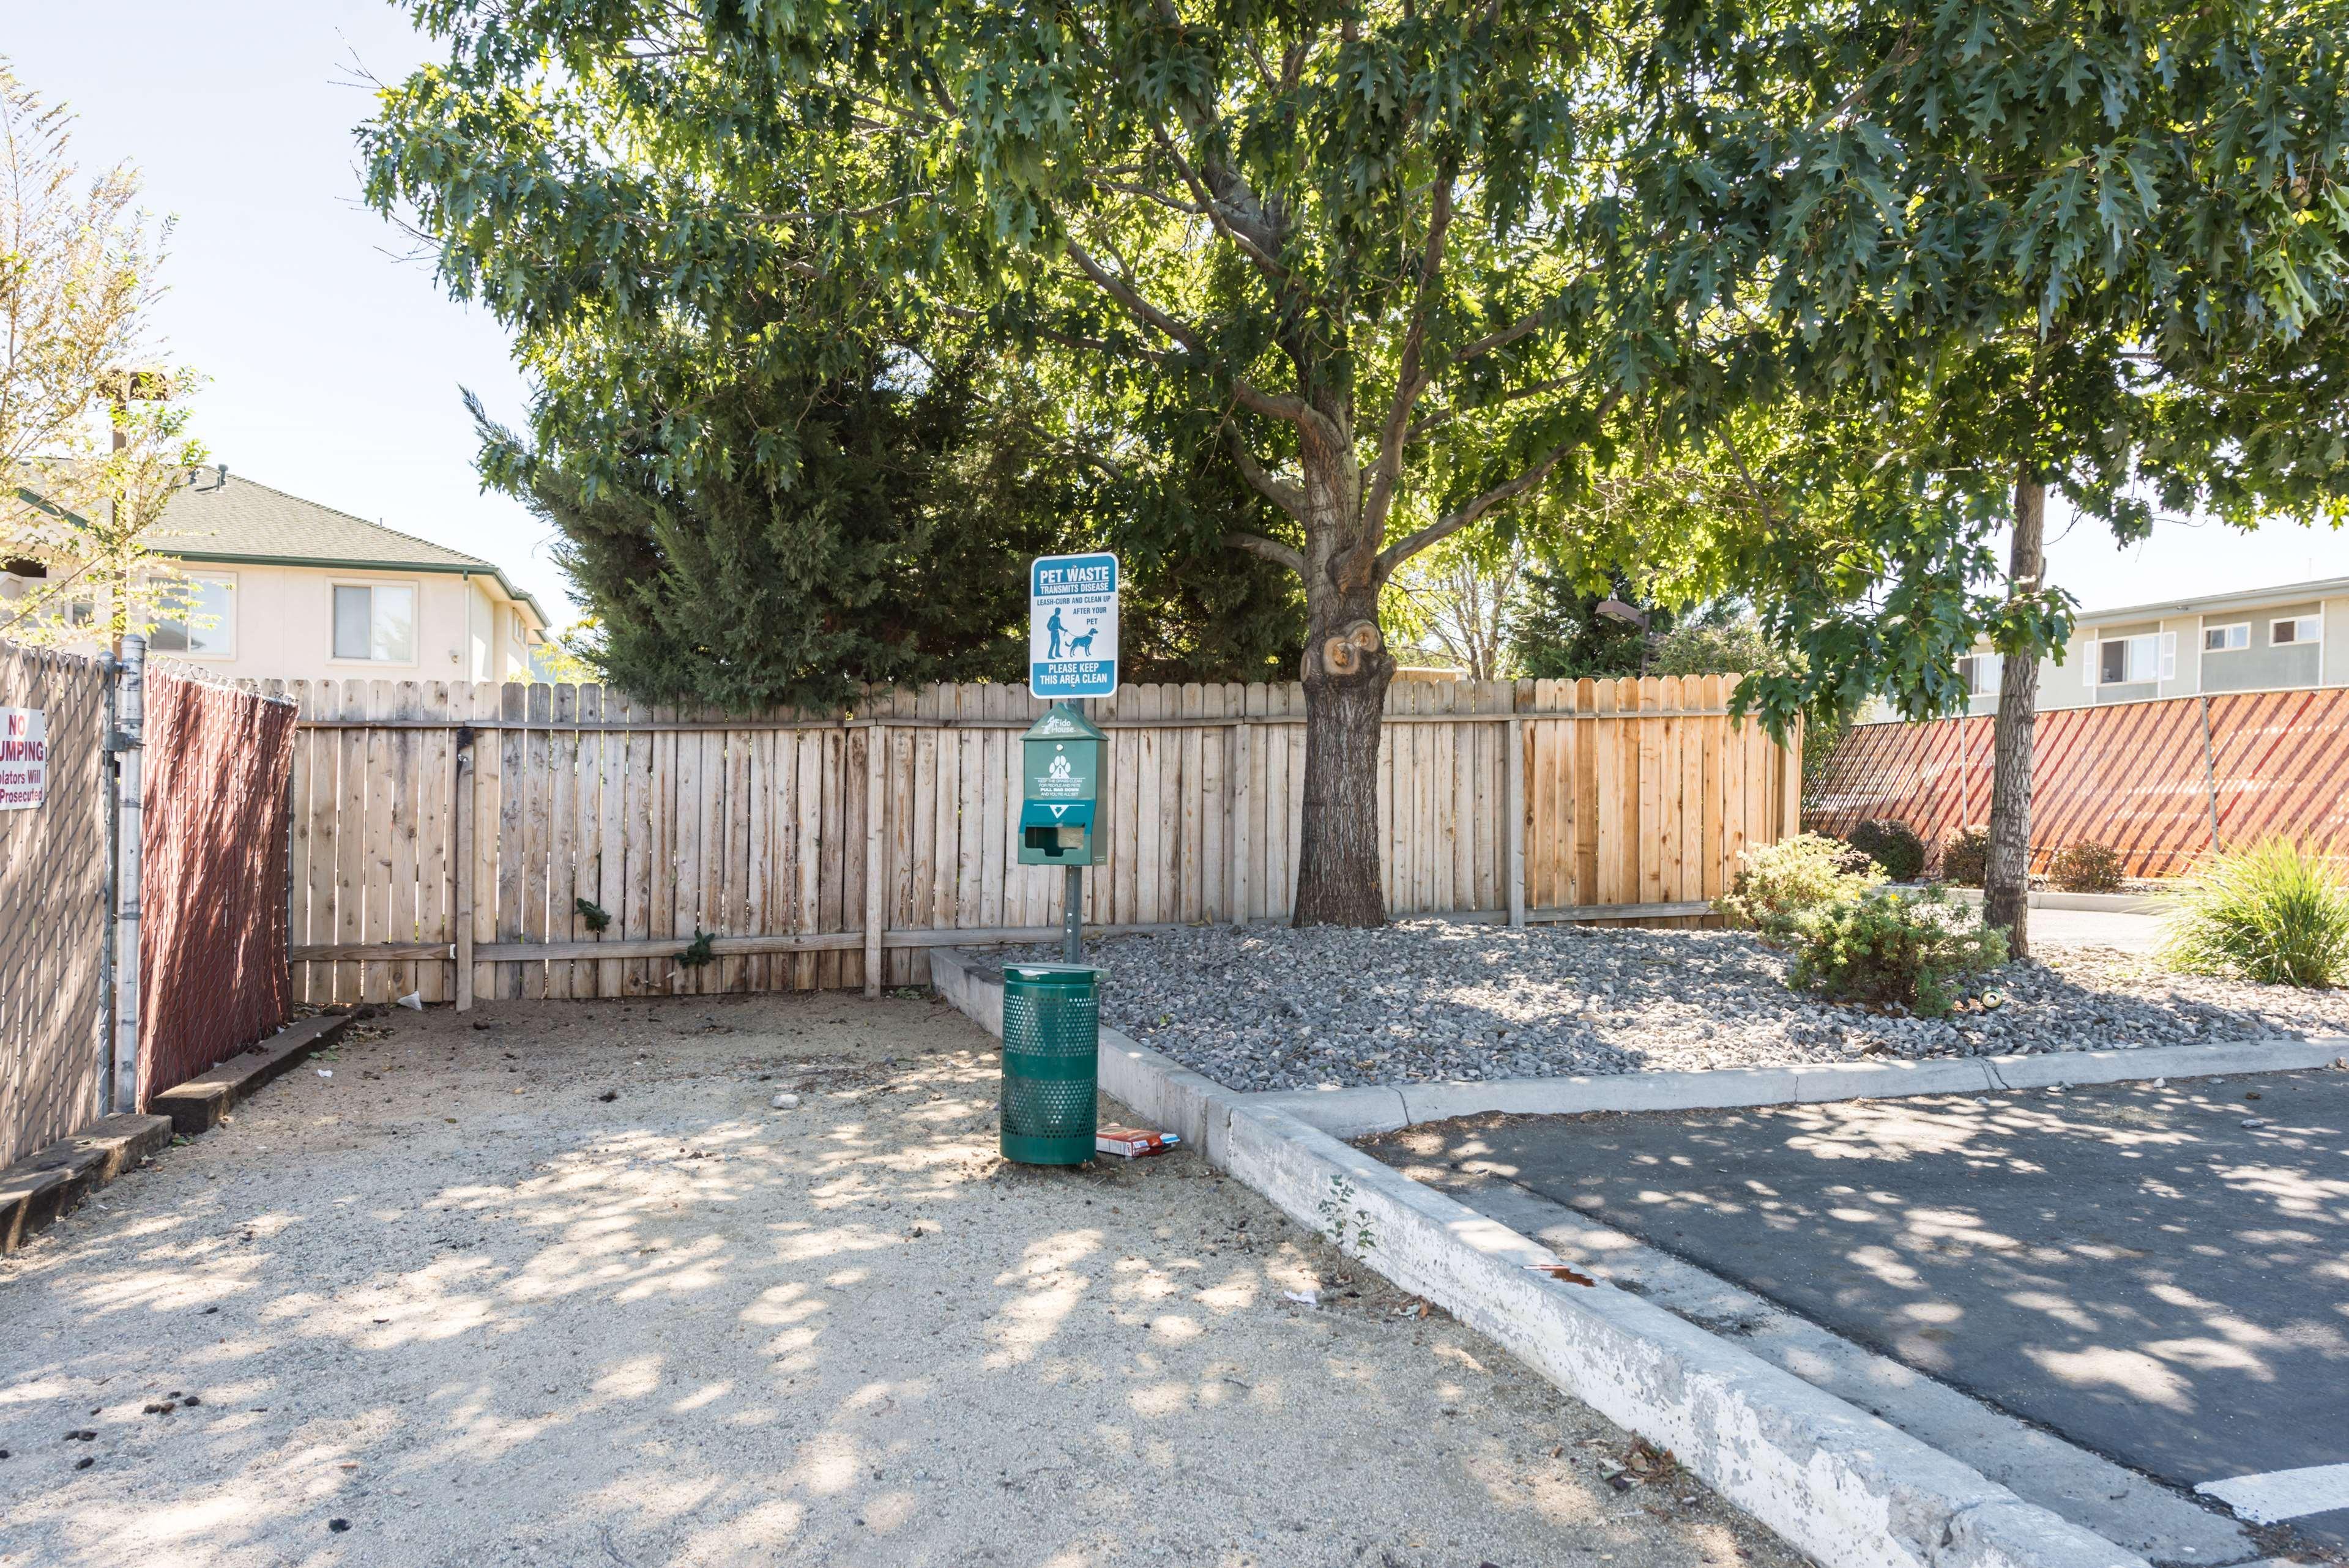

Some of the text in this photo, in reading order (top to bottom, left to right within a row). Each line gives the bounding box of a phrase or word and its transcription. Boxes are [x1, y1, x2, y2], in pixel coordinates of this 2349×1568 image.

[1040, 567, 1109, 584] PET WASTE
[1040, 582, 1109, 595] TRANSMITS DISEASE
[1037, 597, 1070, 606] LEASH-CURB
[1049, 663, 1099, 674] PLEASE KEEP
[1040, 674, 1107, 685] THIS AREA CLEAN
[9, 715, 25, 736] NO
[1054, 718, 1071, 727] Fido
[0, 740, 43, 762] UMPING
[28, 770, 40, 784] Will
[0, 787, 43, 803] Prosecuted
